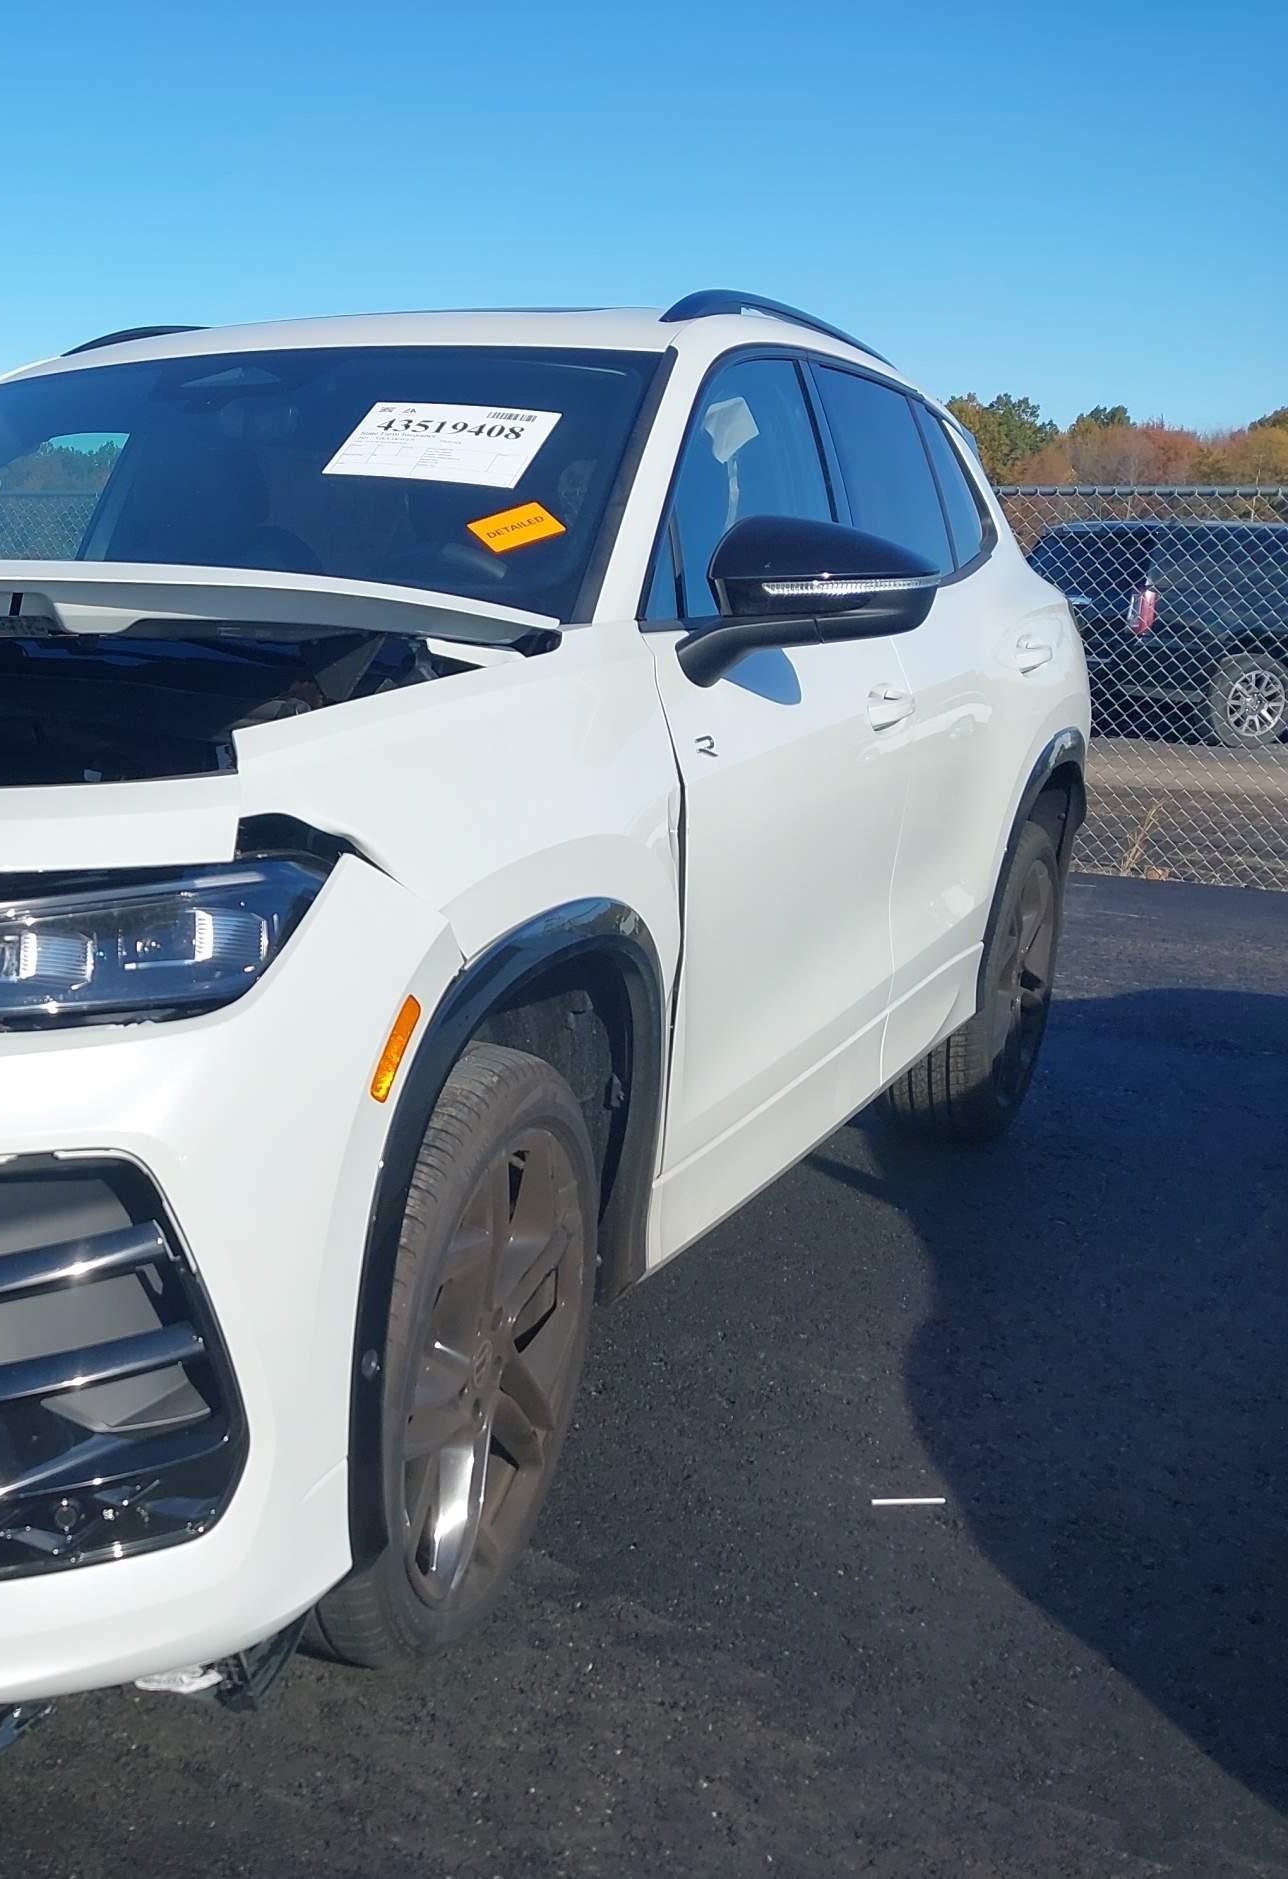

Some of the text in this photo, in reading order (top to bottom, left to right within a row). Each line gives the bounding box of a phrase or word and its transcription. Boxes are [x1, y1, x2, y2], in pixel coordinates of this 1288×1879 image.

[376, 417, 526, 441] 43519408
[486, 515, 545, 539] DETAILED
[694, 734, 720, 758] R
